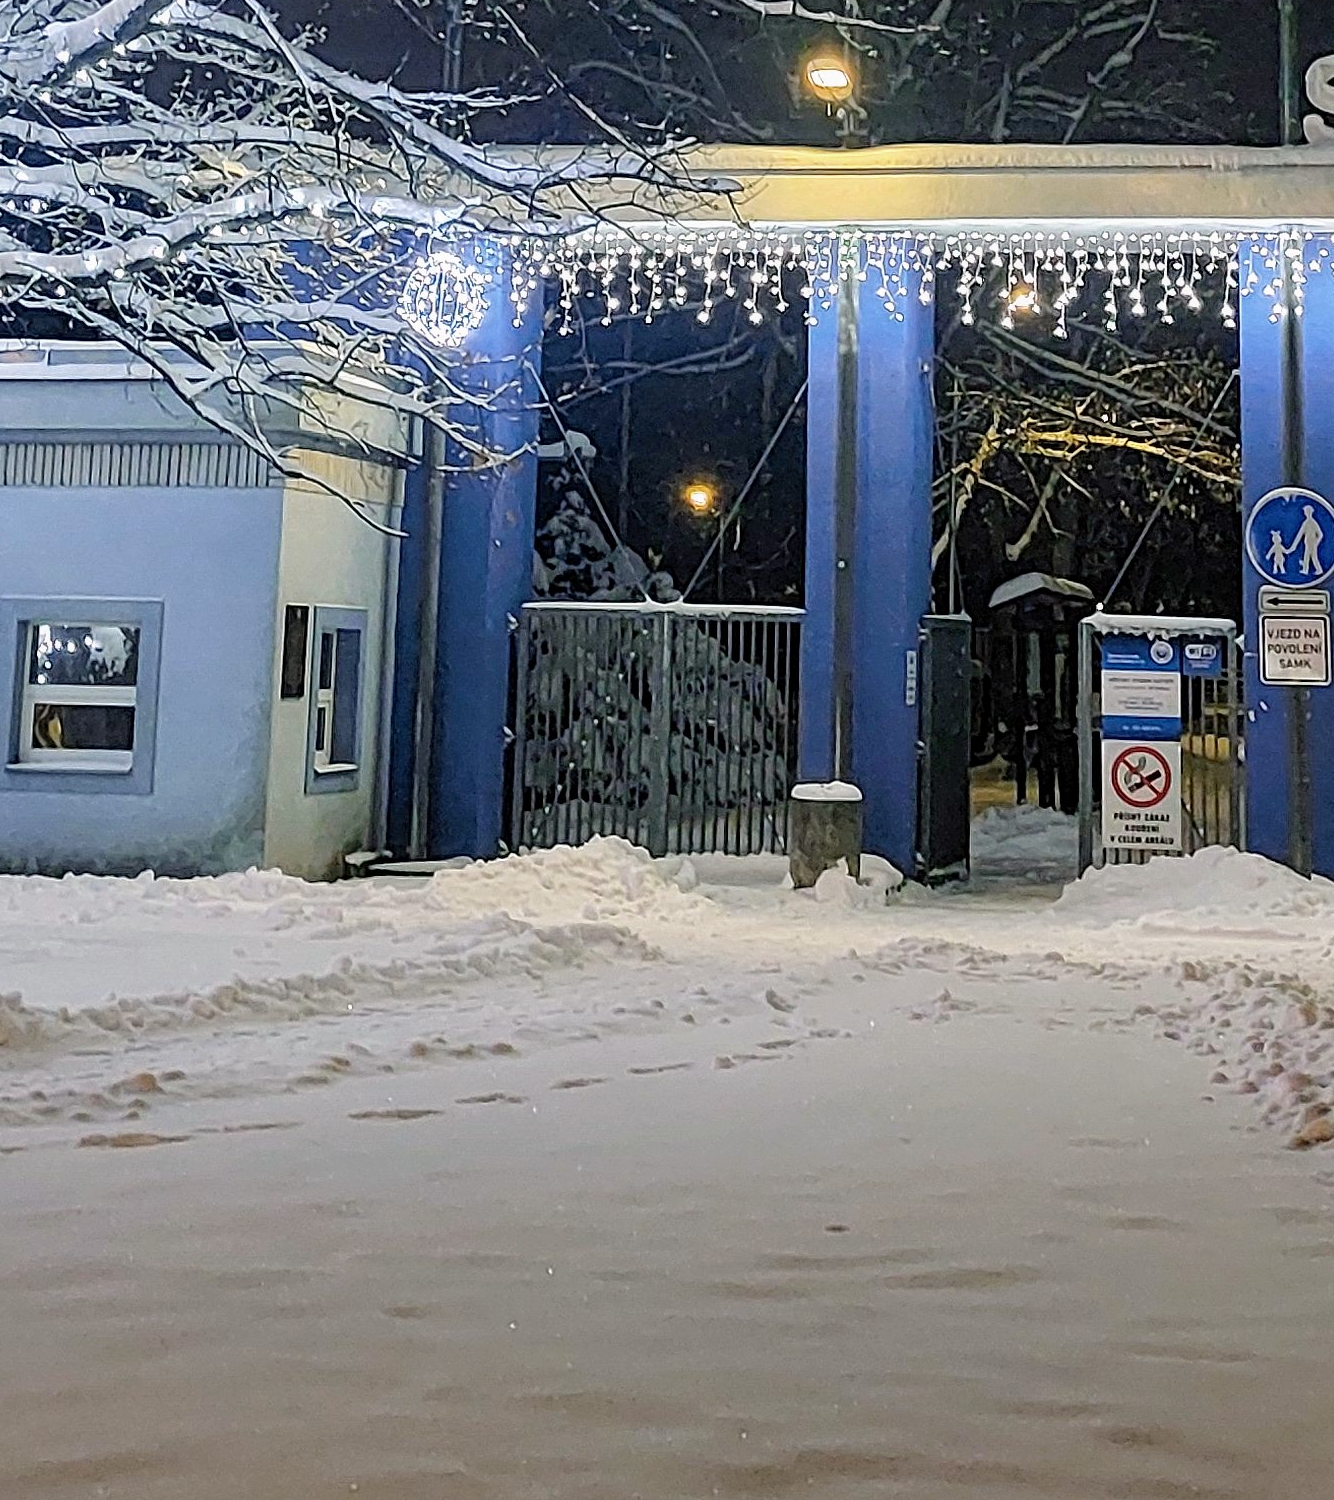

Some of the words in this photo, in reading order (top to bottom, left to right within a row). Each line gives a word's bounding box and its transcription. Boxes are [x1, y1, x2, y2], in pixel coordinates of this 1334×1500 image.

[1267, 628, 1301, 639] VJEZD
[1304, 628, 1320, 639] NA
[1267, 642, 1322, 654] POVOLENÍ
